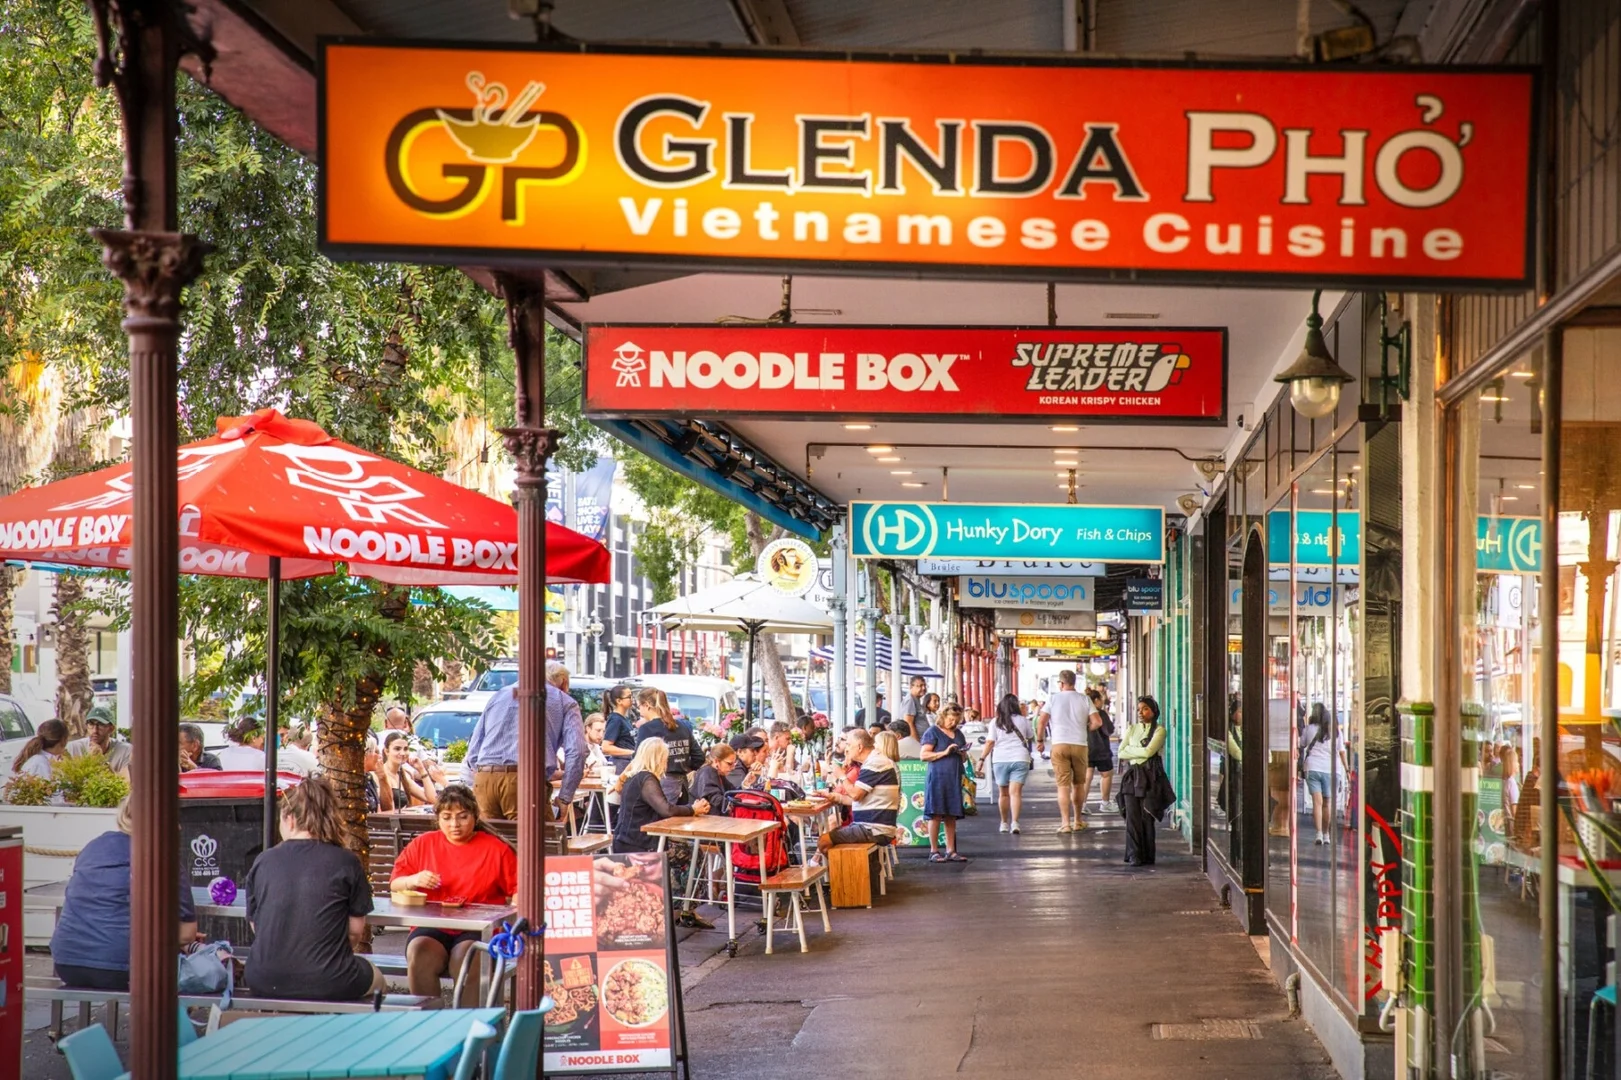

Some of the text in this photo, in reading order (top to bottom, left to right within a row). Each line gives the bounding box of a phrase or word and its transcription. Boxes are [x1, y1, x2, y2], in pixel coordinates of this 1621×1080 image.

[613, 92, 1150, 203] GLENDA
[618, 197, 1465, 261] Vietnamese Cuisine
[1011, 342, 1160, 367] SUPREME
[648, 350, 846, 390] NOODLE
[856, 353, 960, 393] BOX
[1025, 367, 1147, 392] LEADER
[1039, 396, 1161, 406] KOREAN KRISPY CHICKEN
[77, 514, 127, 546] BOX
[946, 518, 1152, 547] Hunky Dory Fish & Chips
[303, 526, 519, 571] NOODLE BOX
[545, 871, 590, 886] ORE
[544, 895, 592, 910] ORE
[544, 909, 593, 929] IRE
[544, 927, 593, 939] ACKER
[568, 1054, 640, 1066] NOODLE BOX
